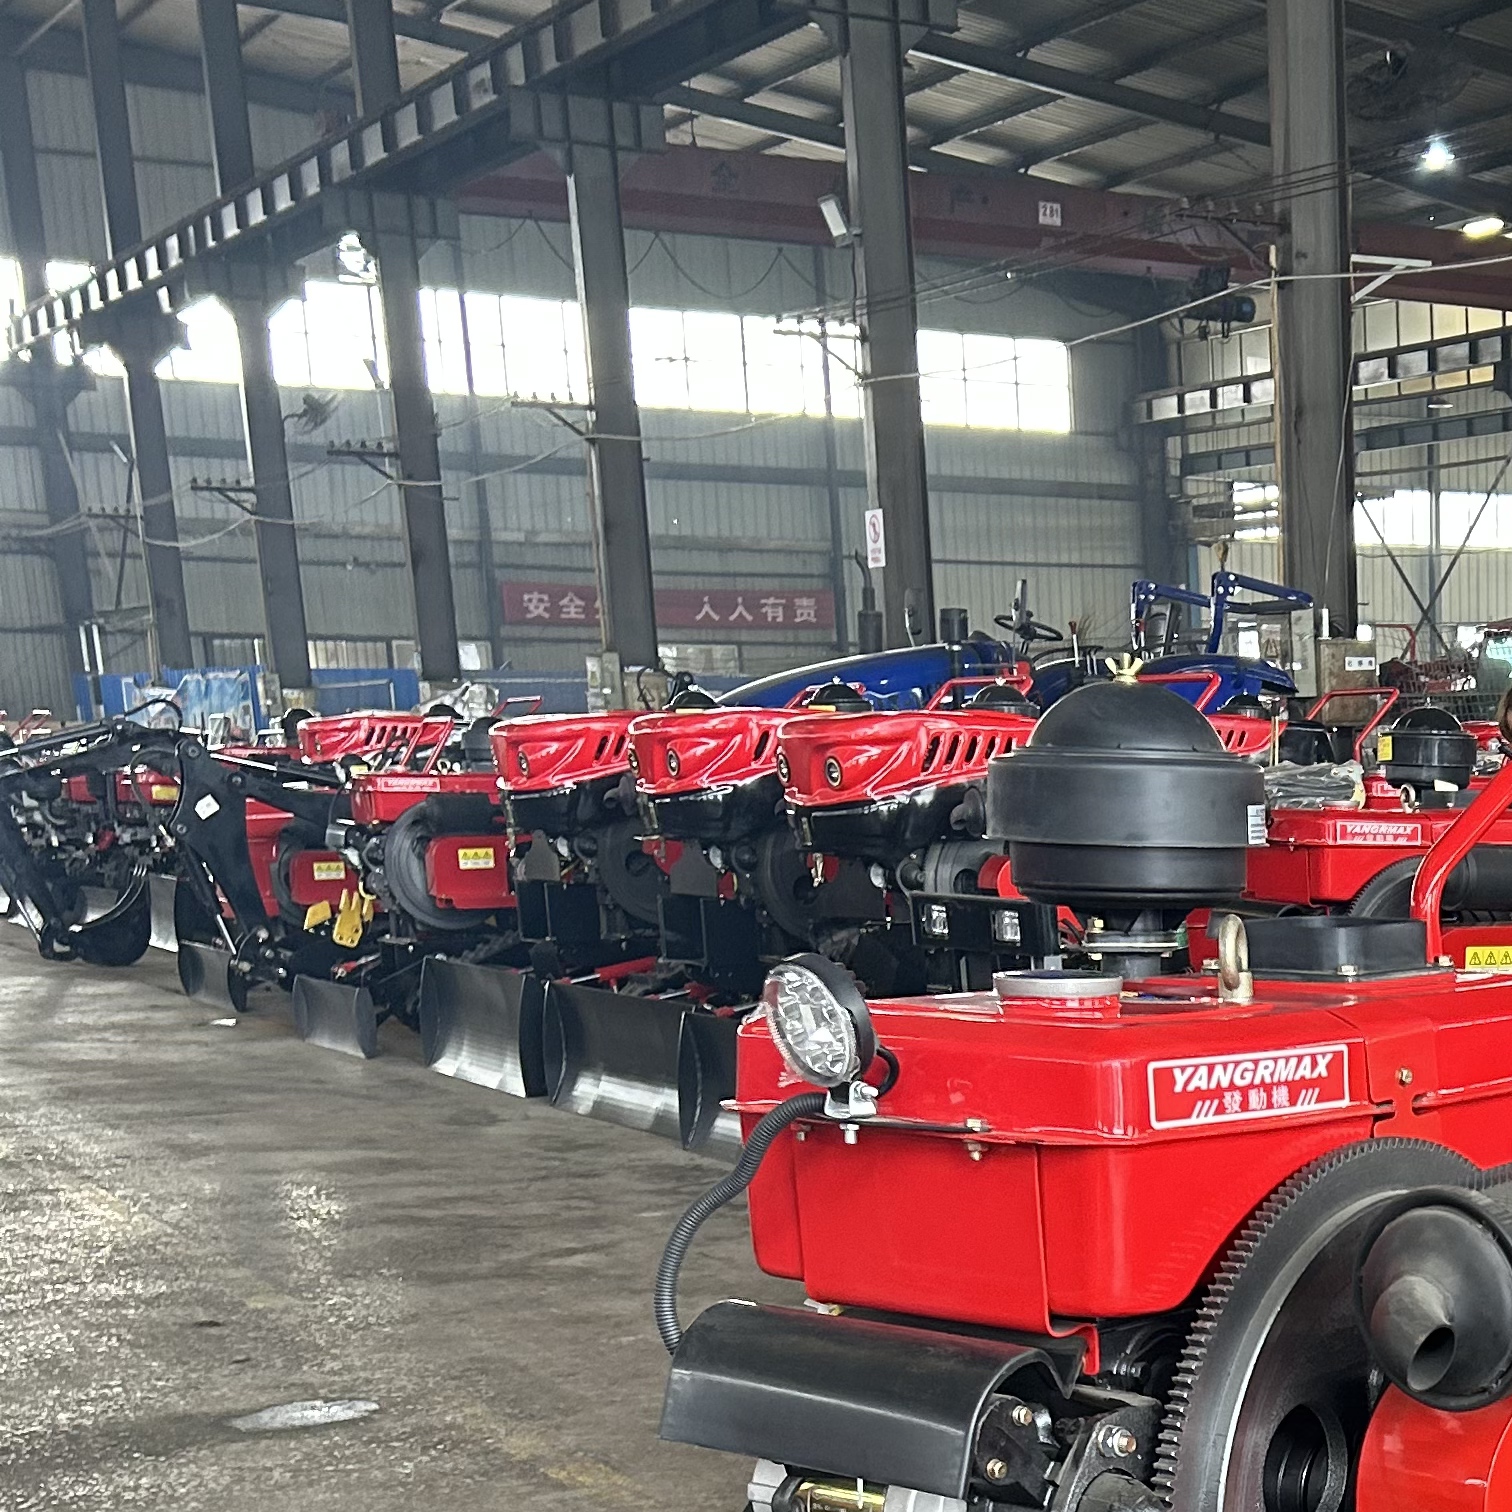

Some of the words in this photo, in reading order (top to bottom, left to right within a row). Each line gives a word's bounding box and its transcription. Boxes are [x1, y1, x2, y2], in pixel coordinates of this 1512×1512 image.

[522, 591, 602, 620] 安全
[695, 596, 817, 622] 人人有责
[1346, 824, 1415, 835] YANGRMAX
[1172, 1052, 1334, 1093] YANGRMAX
